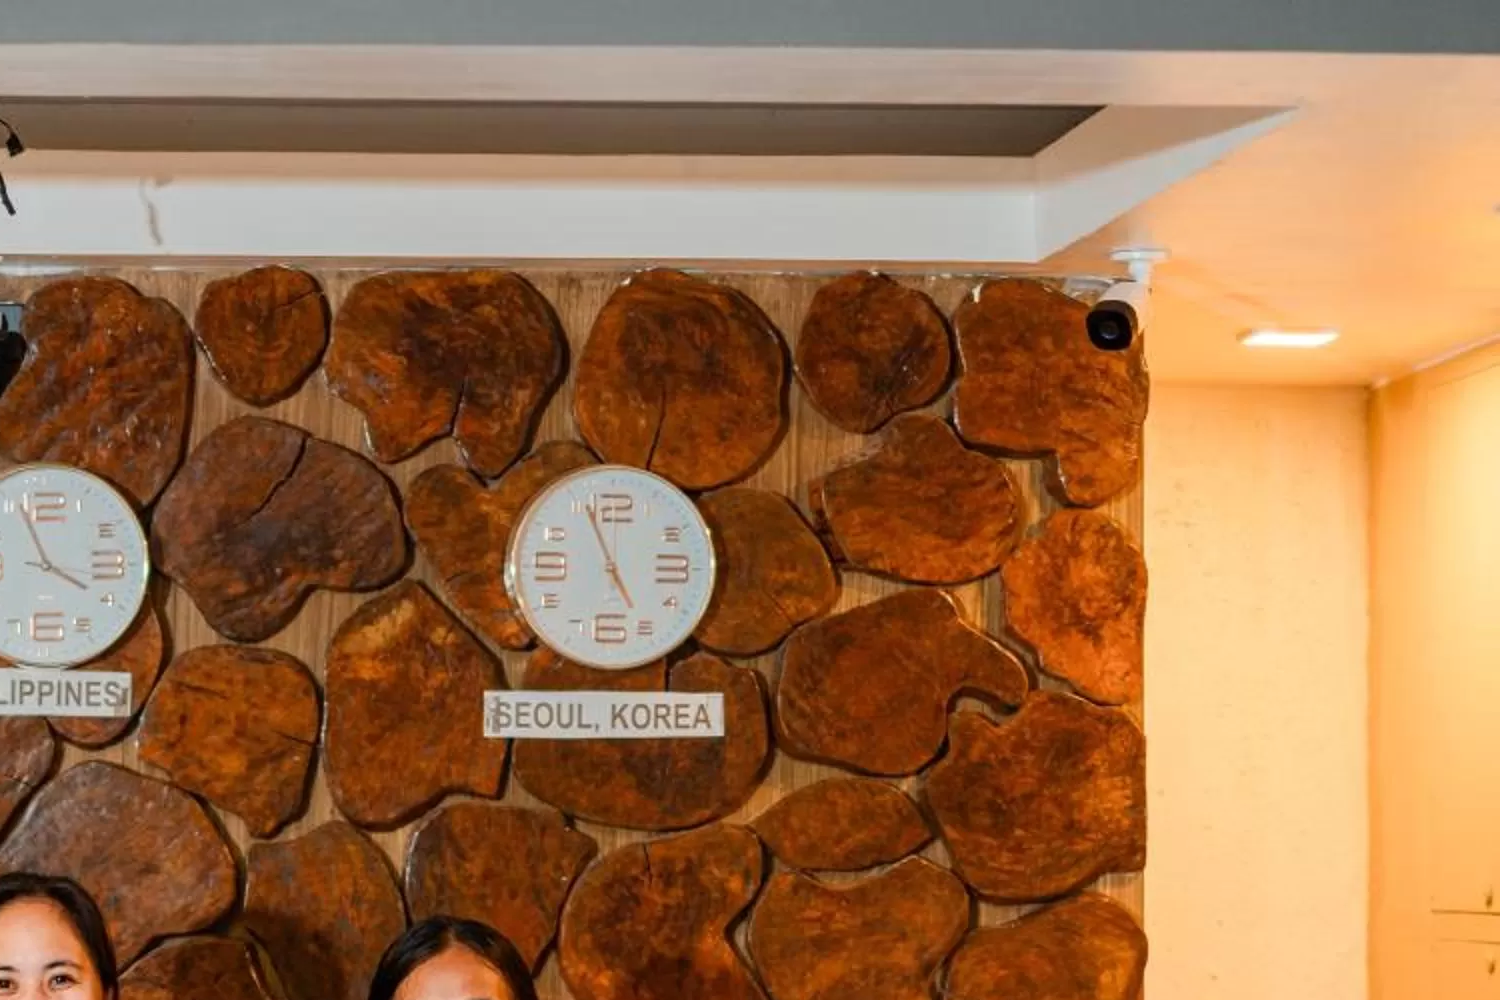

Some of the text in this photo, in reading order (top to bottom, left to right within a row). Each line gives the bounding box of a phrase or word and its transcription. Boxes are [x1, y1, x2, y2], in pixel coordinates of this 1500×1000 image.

[22, 491, 67, 522] 12
[590, 492, 633, 523] 12
[92, 550, 125, 580] 3
[533, 552, 567, 581] 9
[655, 554, 689, 583] 3
[100, 592, 115, 607] 4
[6, 619, 22, 635] 7
[29, 612, 65, 641] 6
[592, 613, 627, 643] 6
[496, 701, 712, 732] SEOUL, KOREA
